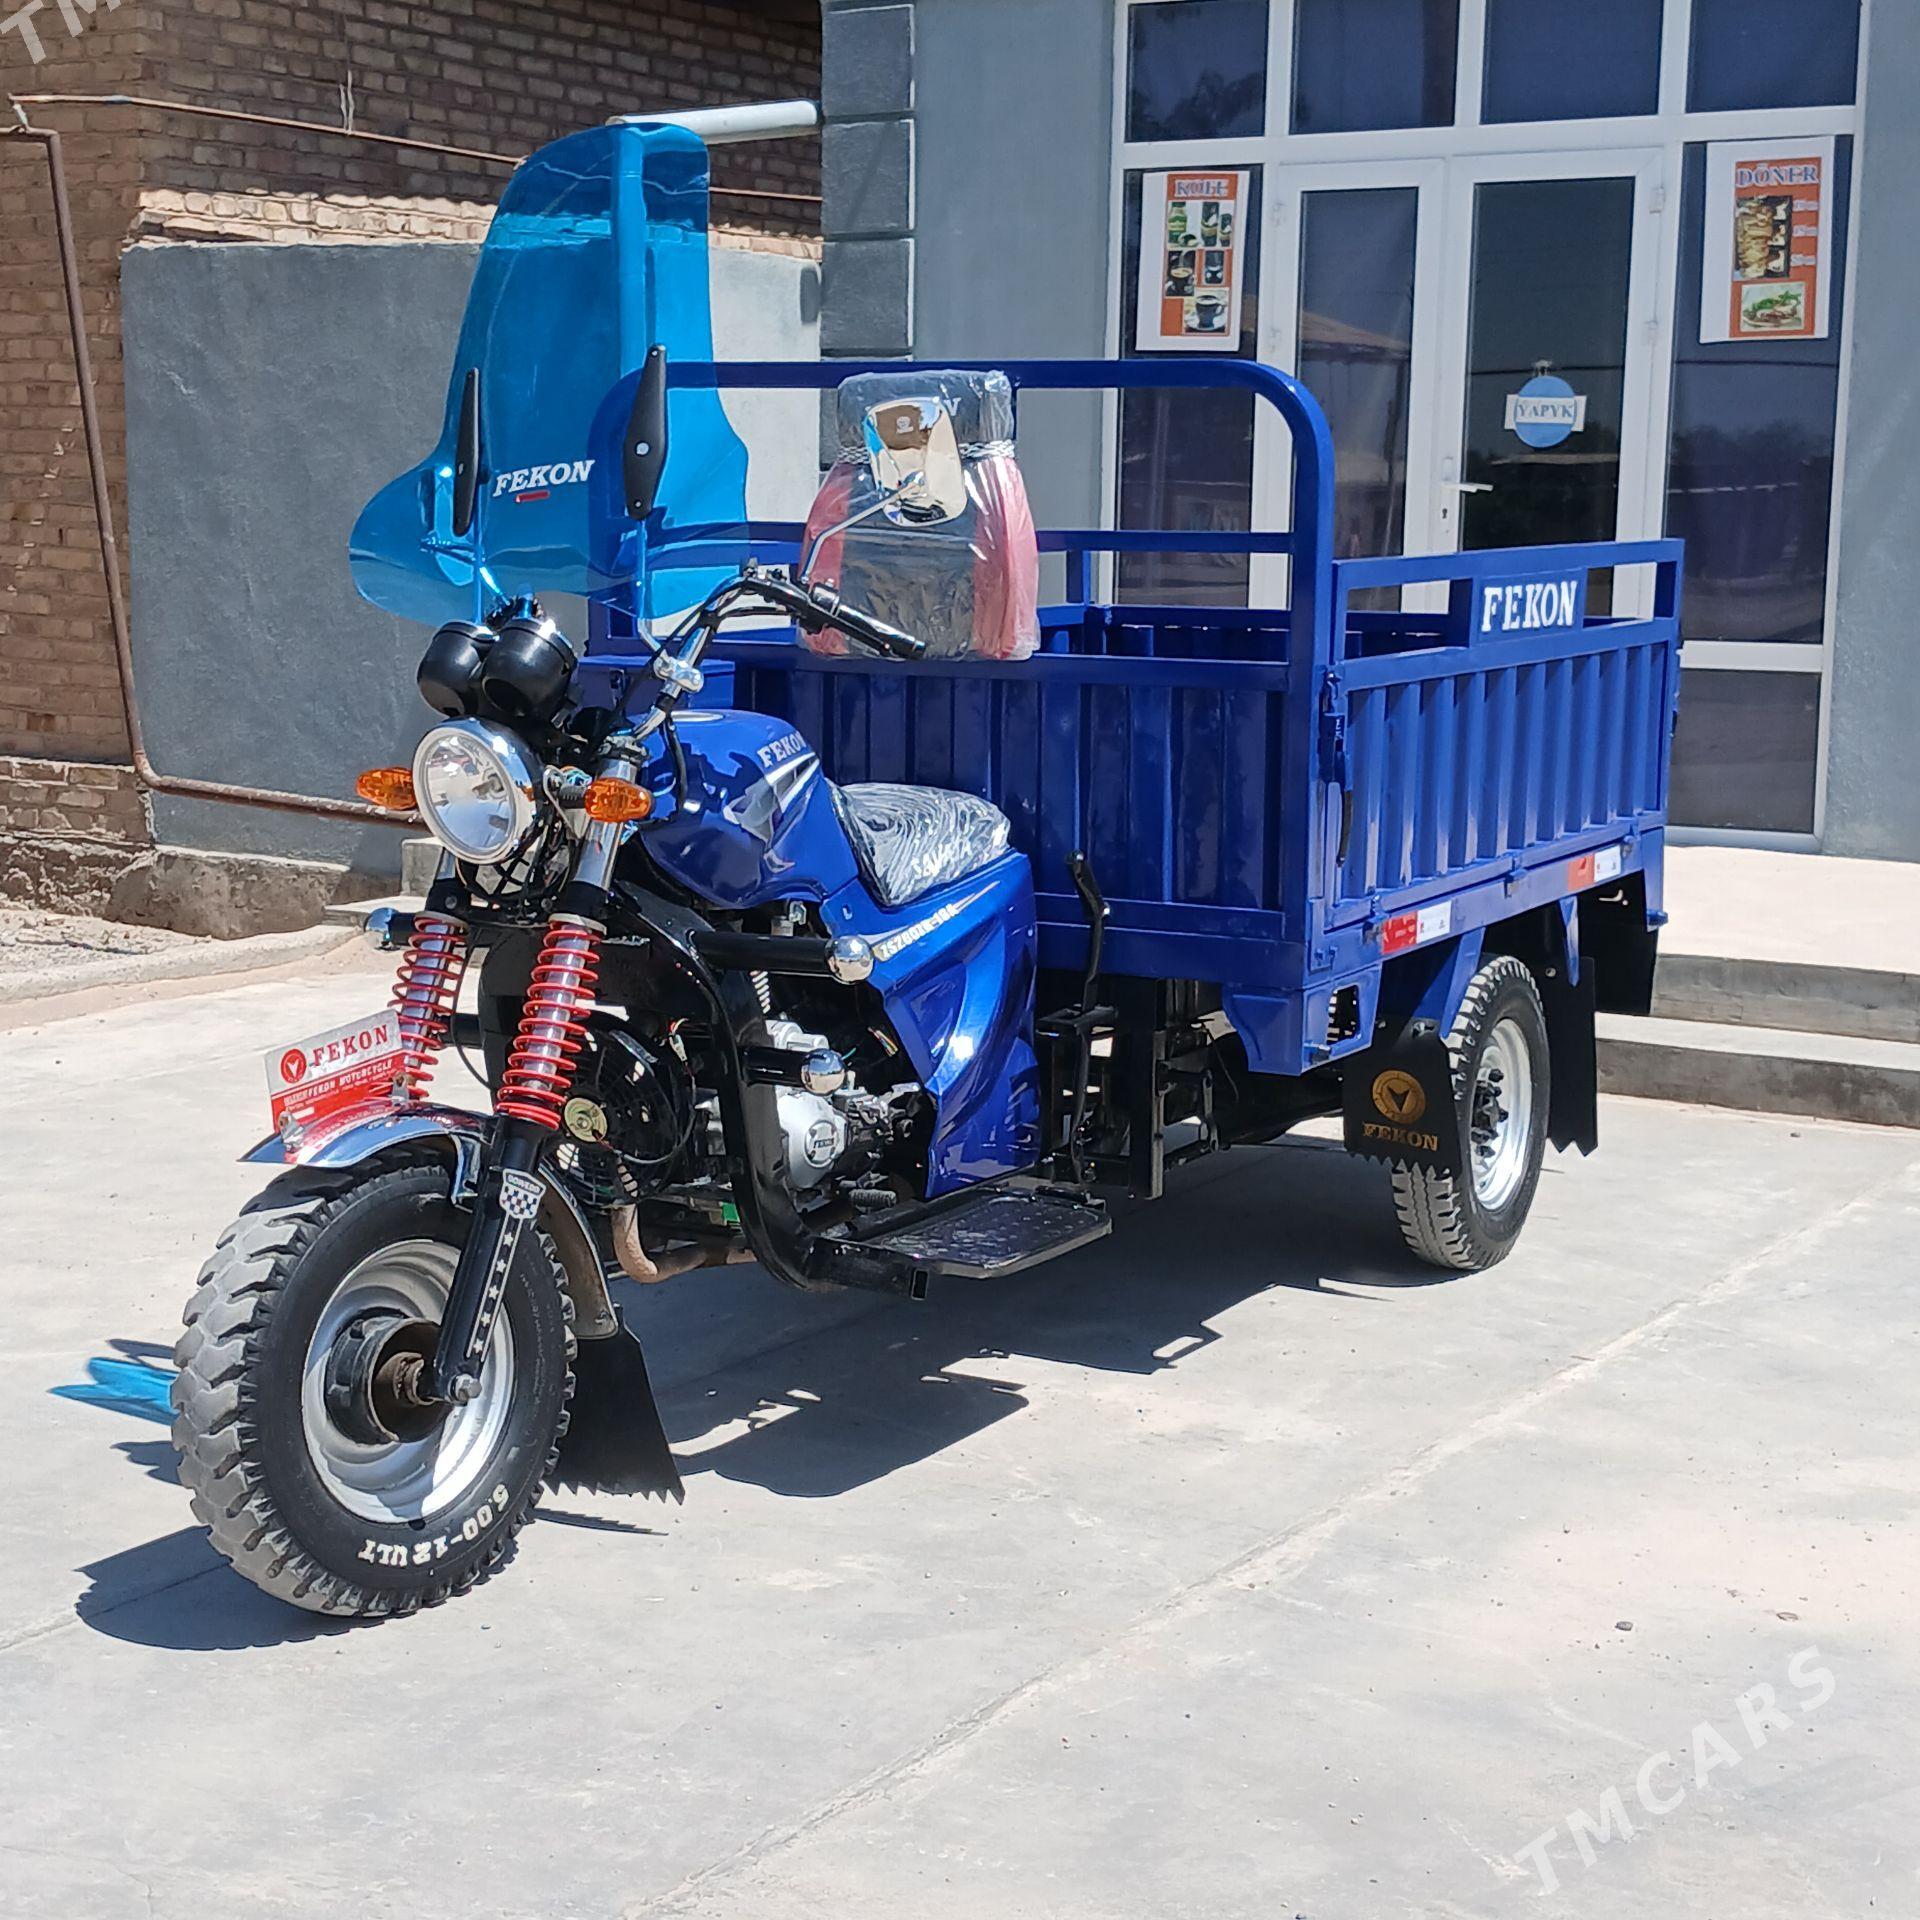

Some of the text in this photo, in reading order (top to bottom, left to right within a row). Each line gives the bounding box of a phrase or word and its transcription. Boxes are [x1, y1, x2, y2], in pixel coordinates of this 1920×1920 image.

[492, 459, 596, 497] FEKON
[1481, 581, 1578, 632] FEKON
[312, 1024, 388, 1066] FEKON
[1362, 1121, 1438, 1152] FEKON
